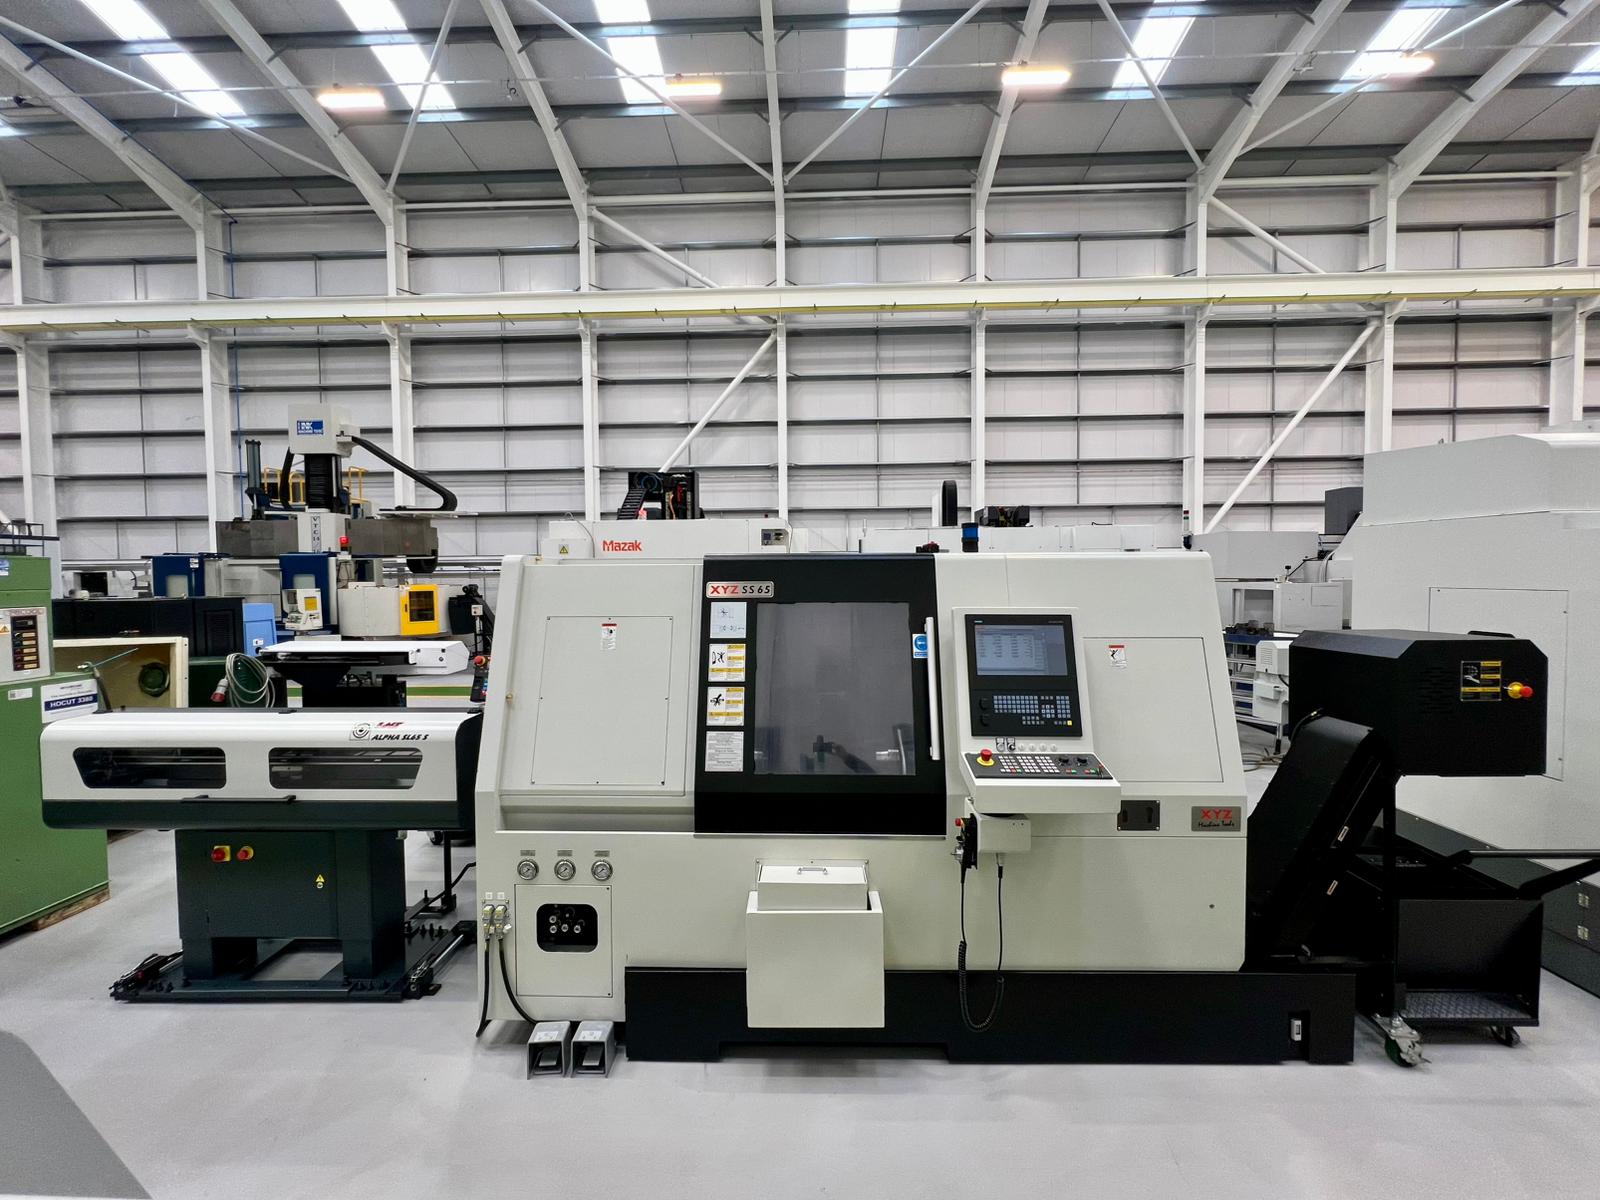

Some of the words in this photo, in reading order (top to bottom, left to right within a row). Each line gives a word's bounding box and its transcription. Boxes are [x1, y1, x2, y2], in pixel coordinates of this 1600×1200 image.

[602, 539, 643, 552] Mazak
[710, 585, 739, 595] XYZ
[741, 585, 755, 595] SS
[757, 585, 771, 595] 65
[50, 698, 76, 708] HOCUT
[1200, 808, 1233, 821] XYZ
